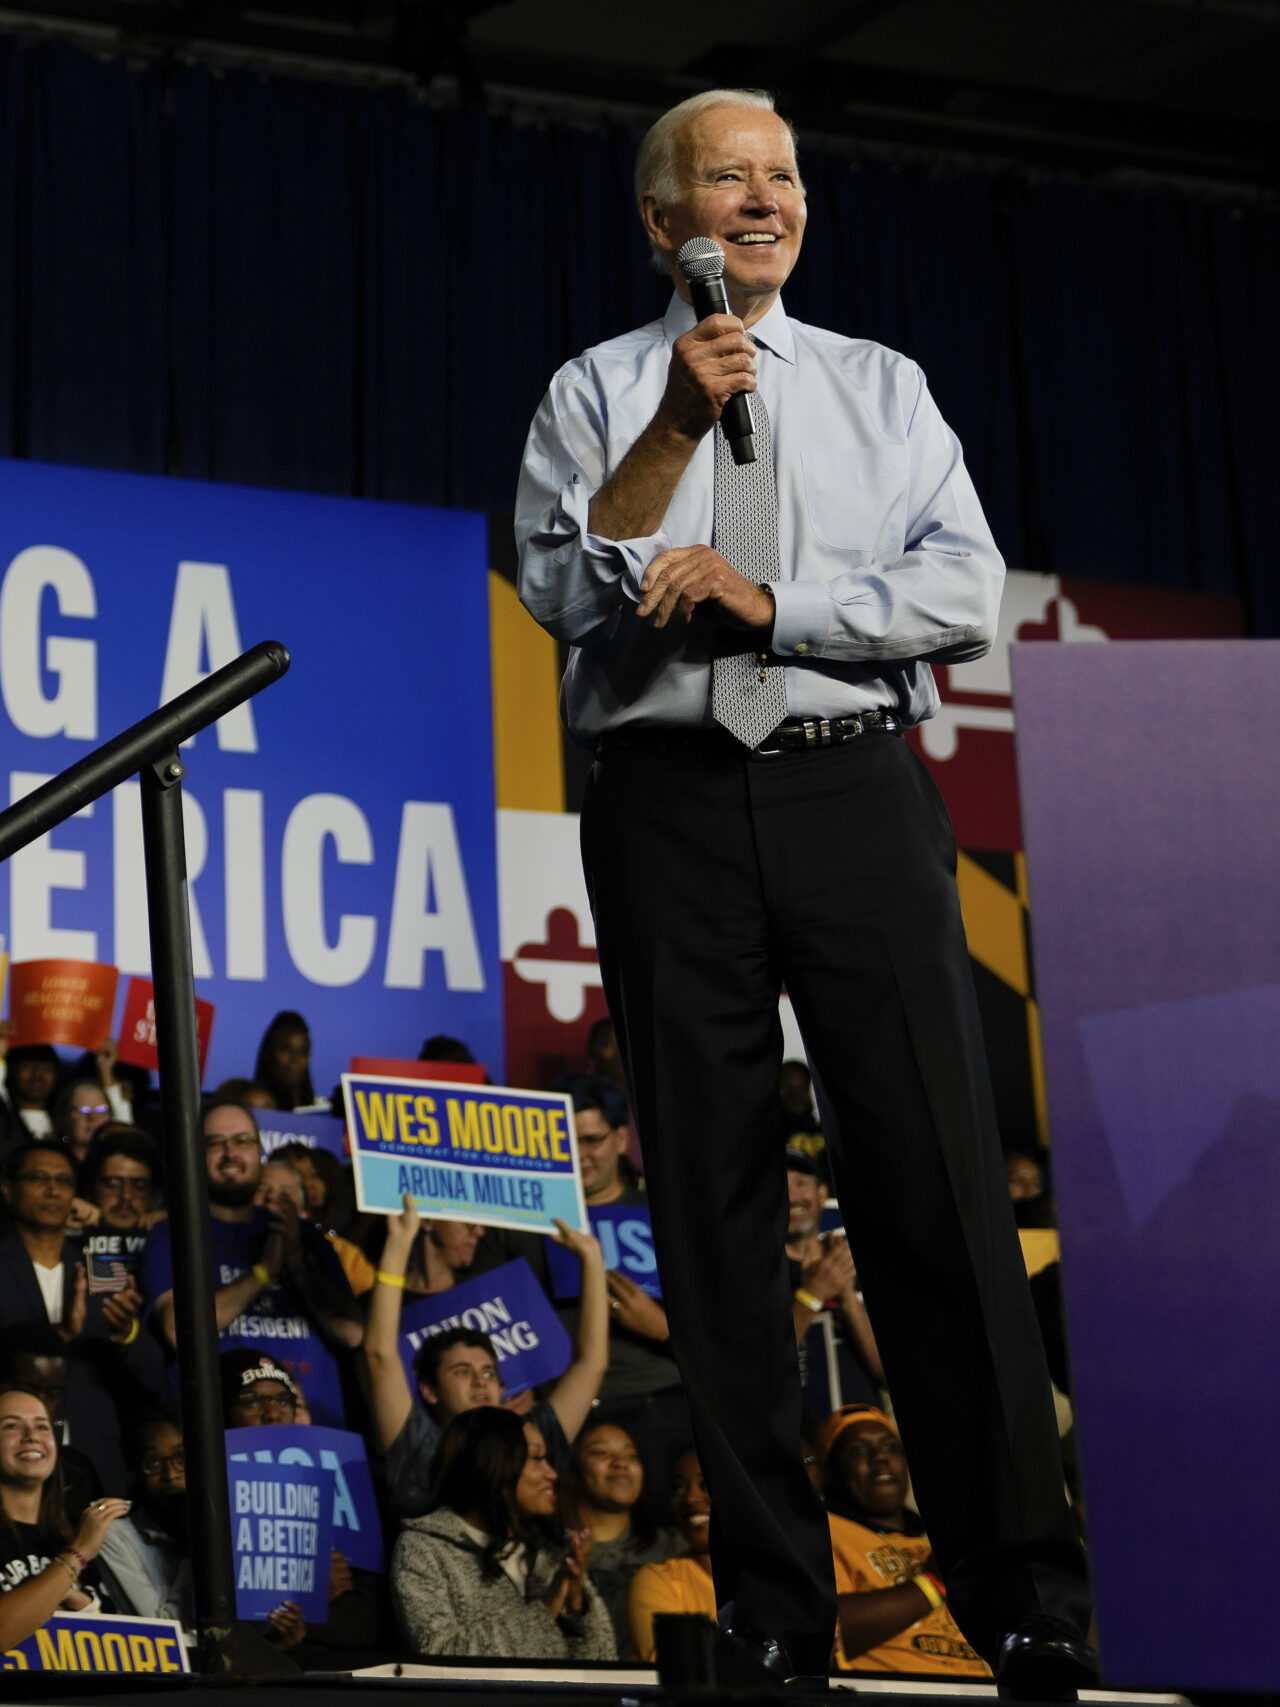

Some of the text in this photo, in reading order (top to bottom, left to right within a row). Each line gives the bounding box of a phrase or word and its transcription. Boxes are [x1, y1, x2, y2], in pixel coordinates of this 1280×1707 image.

[158, 560, 258, 753] A
[354, 1090, 571, 1162] WES MOORE
[398, 1164, 468, 1202] ARUNA
[472, 1173, 545, 1211] MILLER
[88, 1235, 121, 1255] JOE
[235, 1479, 319, 1520] BUILDING
[236, 1517, 319, 1557] A BETTER
[237, 1555, 316, 1593] AMERICA
